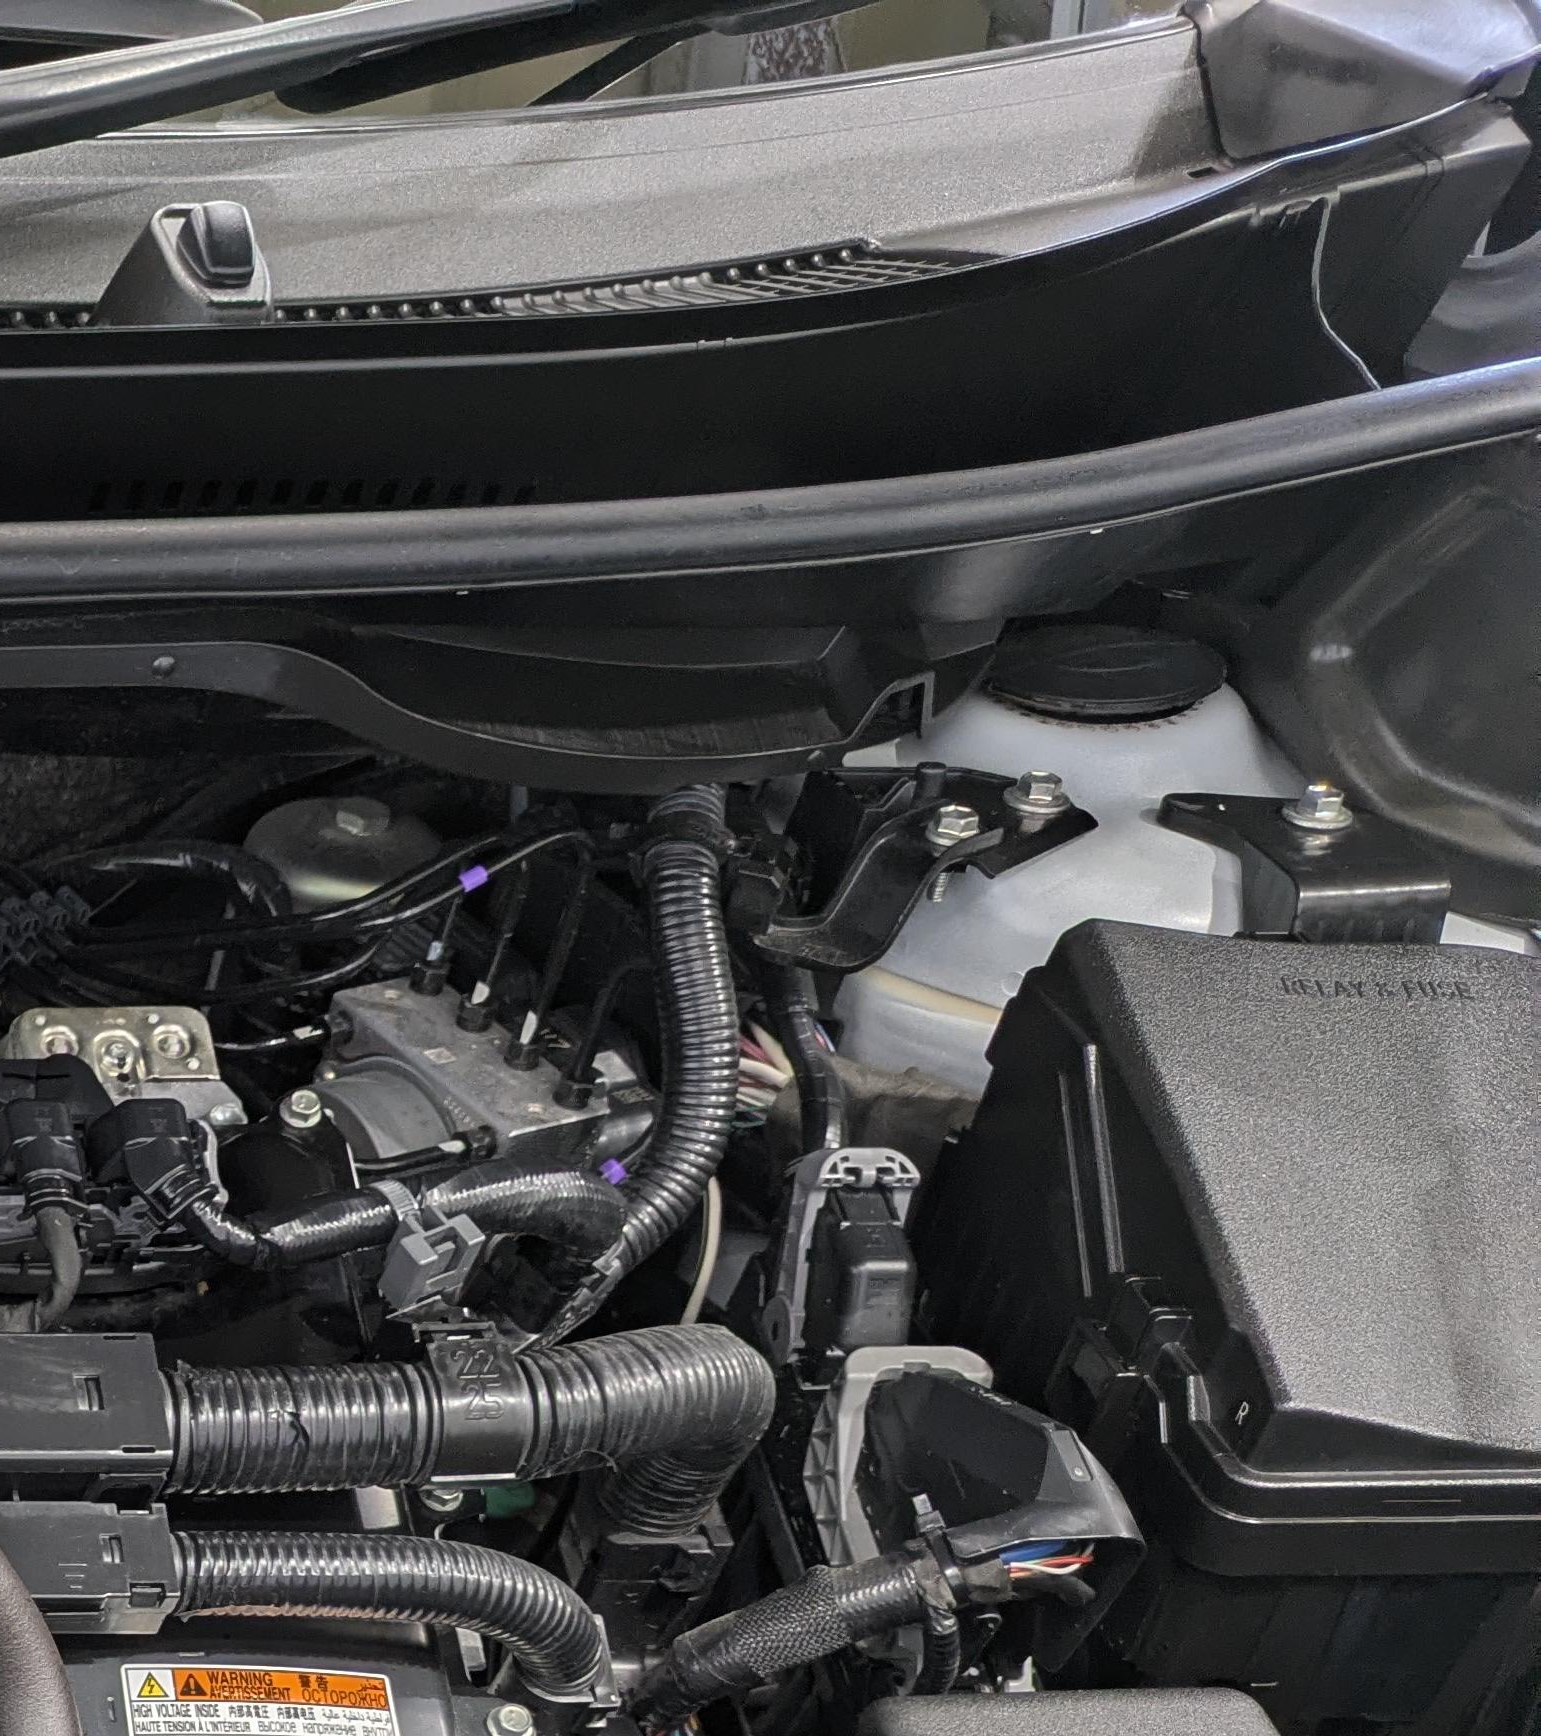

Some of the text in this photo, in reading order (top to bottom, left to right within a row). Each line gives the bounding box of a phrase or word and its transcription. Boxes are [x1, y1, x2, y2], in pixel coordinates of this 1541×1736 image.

[452, 1349, 500, 1379] 22
[462, 1382, 505, 1421] 25
[207, 1671, 273, 1687] WARNING
[210, 1685, 291, 1701] AVERTISSEMENT
[302, 1688, 388, 1708] ОСТОРОЖНО
[134, 1703, 221, 1718] HIGH VOLTAGE INSIDE
[136, 1720, 161, 1732] HAUTE
[164, 1721, 196, 1732] TENSION
